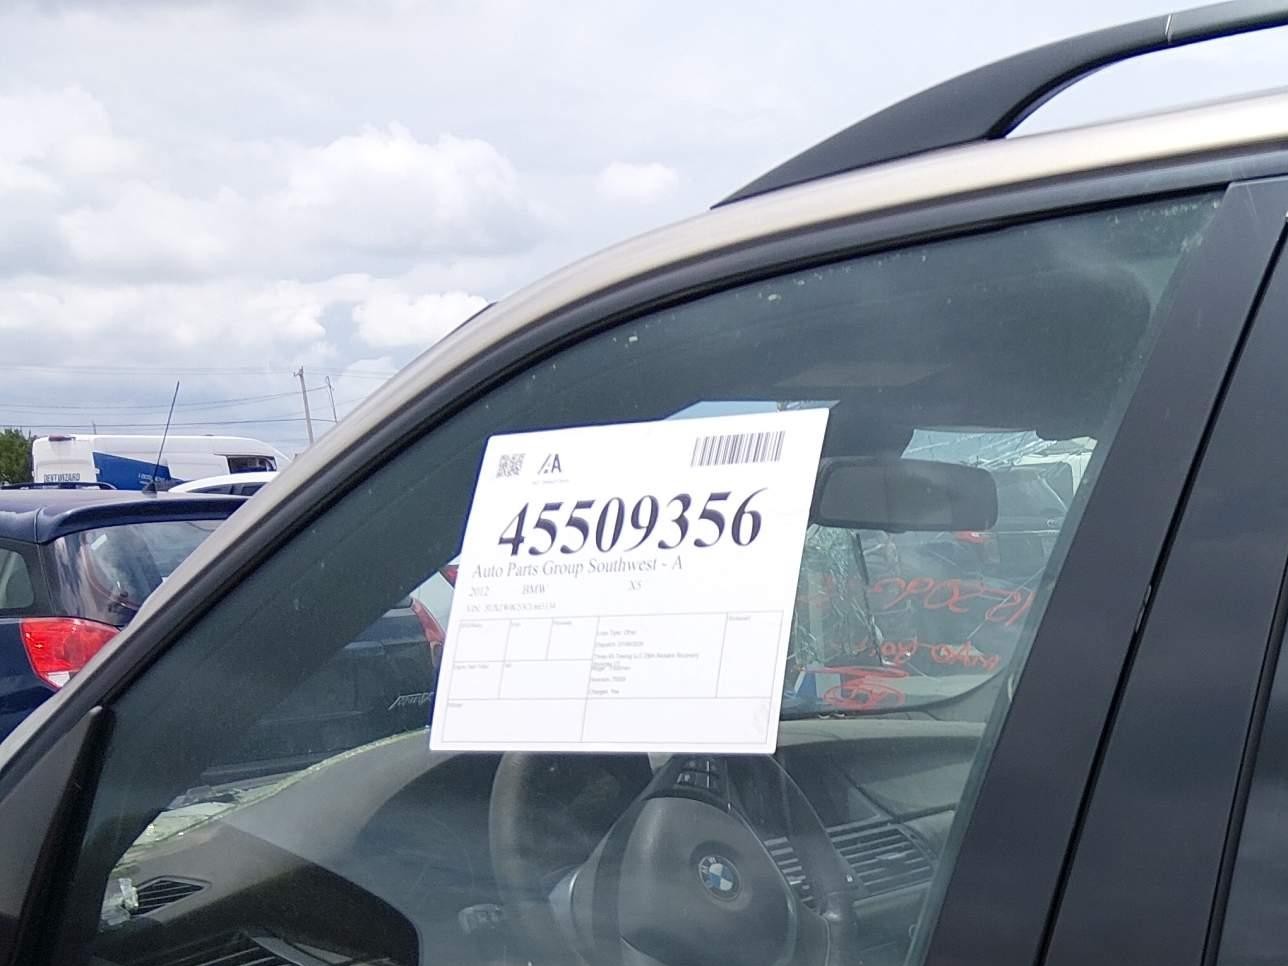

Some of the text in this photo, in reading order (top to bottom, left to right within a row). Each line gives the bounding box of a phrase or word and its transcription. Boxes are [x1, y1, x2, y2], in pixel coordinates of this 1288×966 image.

[498, 487, 768, 556] 45509356
[472, 564, 504, 579] Auto
[507, 562, 539, 577] Parts
[542, 559, 584, 579] Group
[588, 556, 657, 574] Southwest
[672, 556, 683, 570] A
[522, 584, 546, 595] BMW
